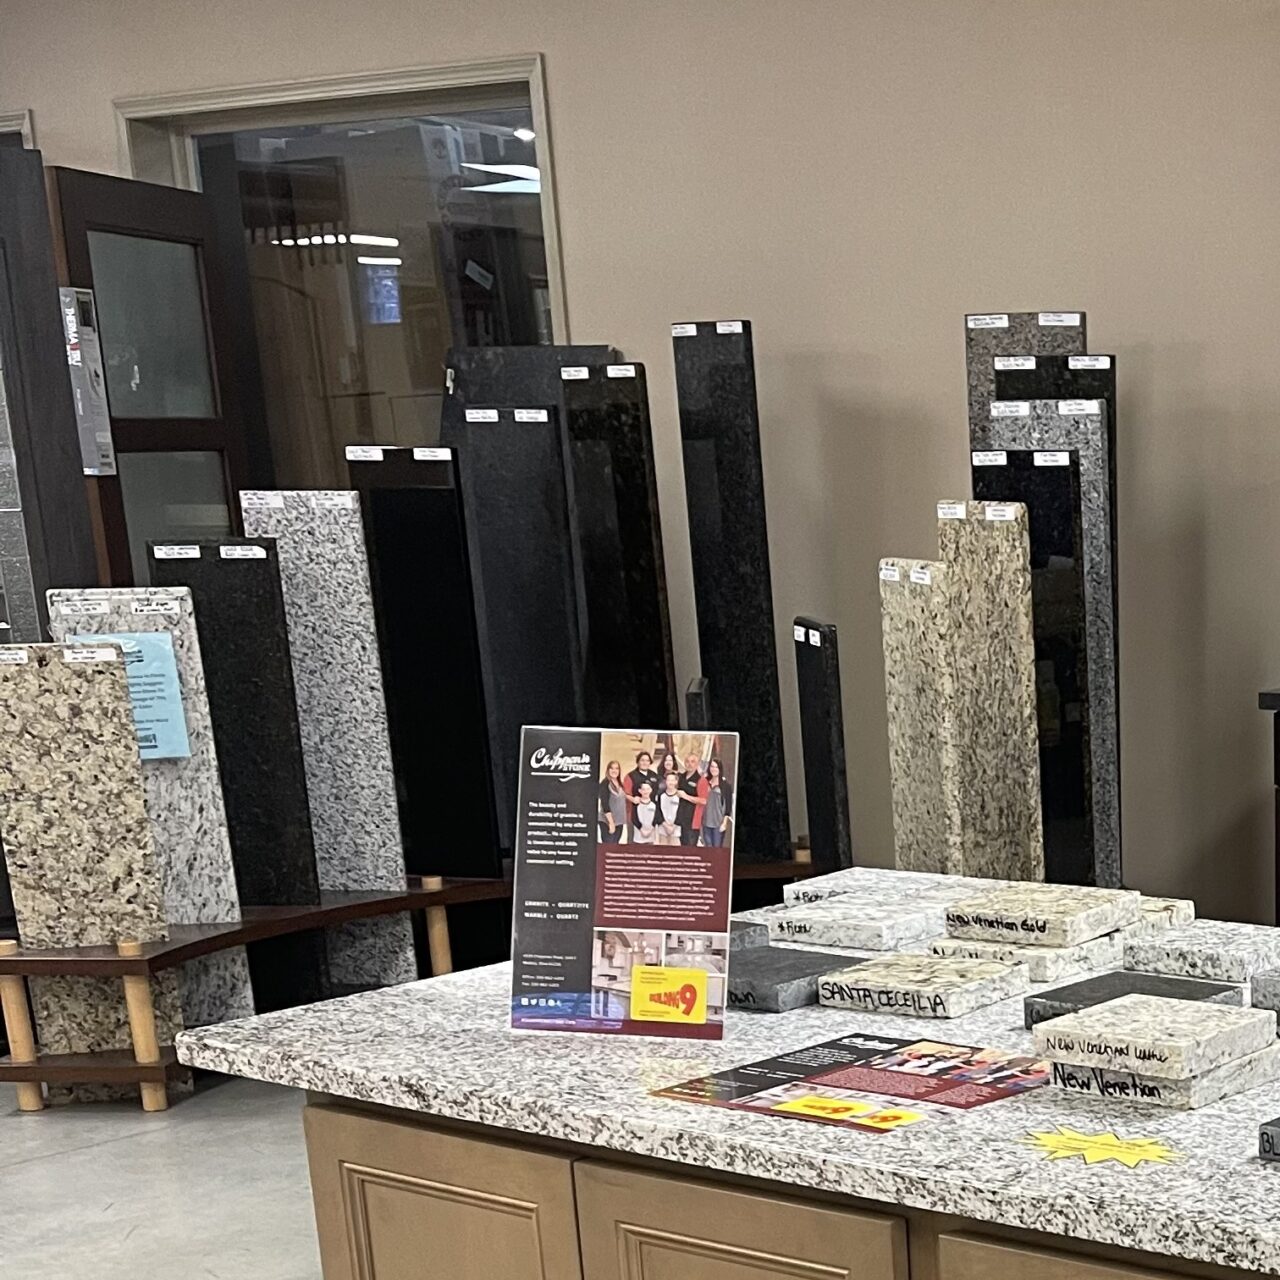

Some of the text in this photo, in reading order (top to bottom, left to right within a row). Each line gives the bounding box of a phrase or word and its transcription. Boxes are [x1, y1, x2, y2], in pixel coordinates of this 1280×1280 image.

[679, 983, 697, 1016] 9
[821, 982, 873, 1004] SANTA
[1053, 1061, 1162, 1099] New Venetian
